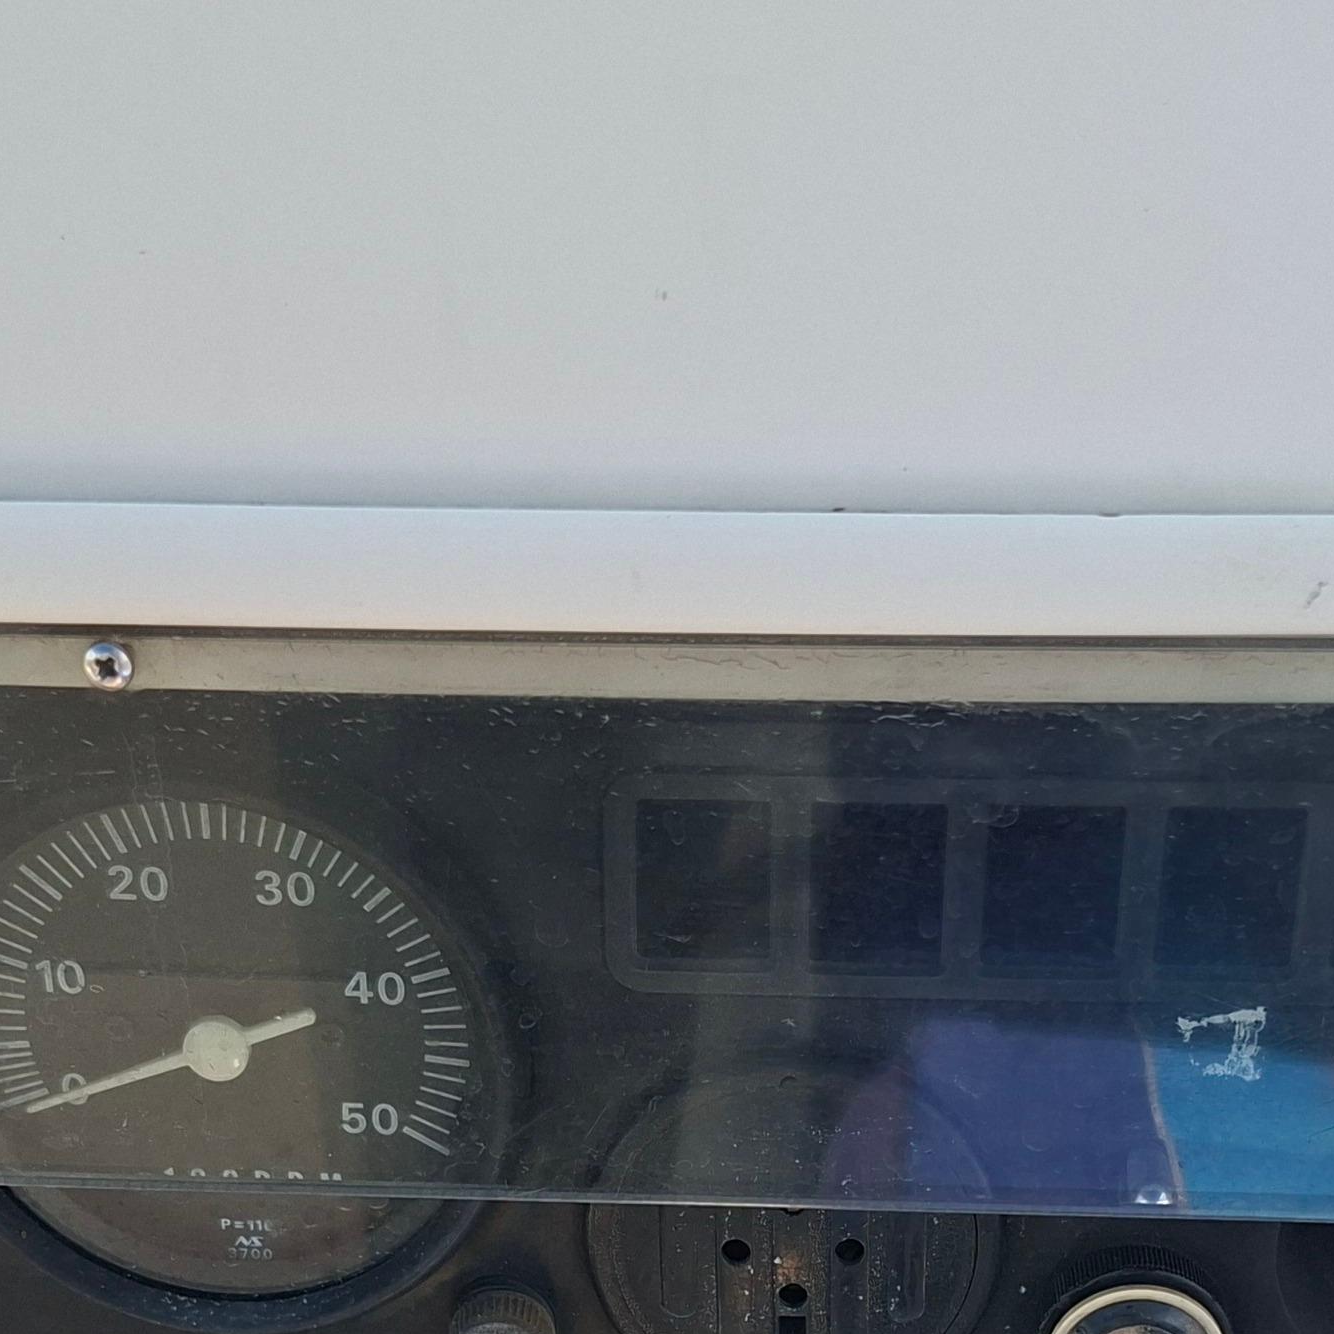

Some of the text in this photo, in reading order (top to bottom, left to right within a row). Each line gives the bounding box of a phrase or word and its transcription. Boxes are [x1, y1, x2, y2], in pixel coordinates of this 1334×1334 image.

[108, 865, 168, 901] 20
[255, 871, 315, 907] 30
[35, 959, 85, 995] 10
[345, 971, 405, 1005] 40
[341, 1103, 399, 1135] 50
